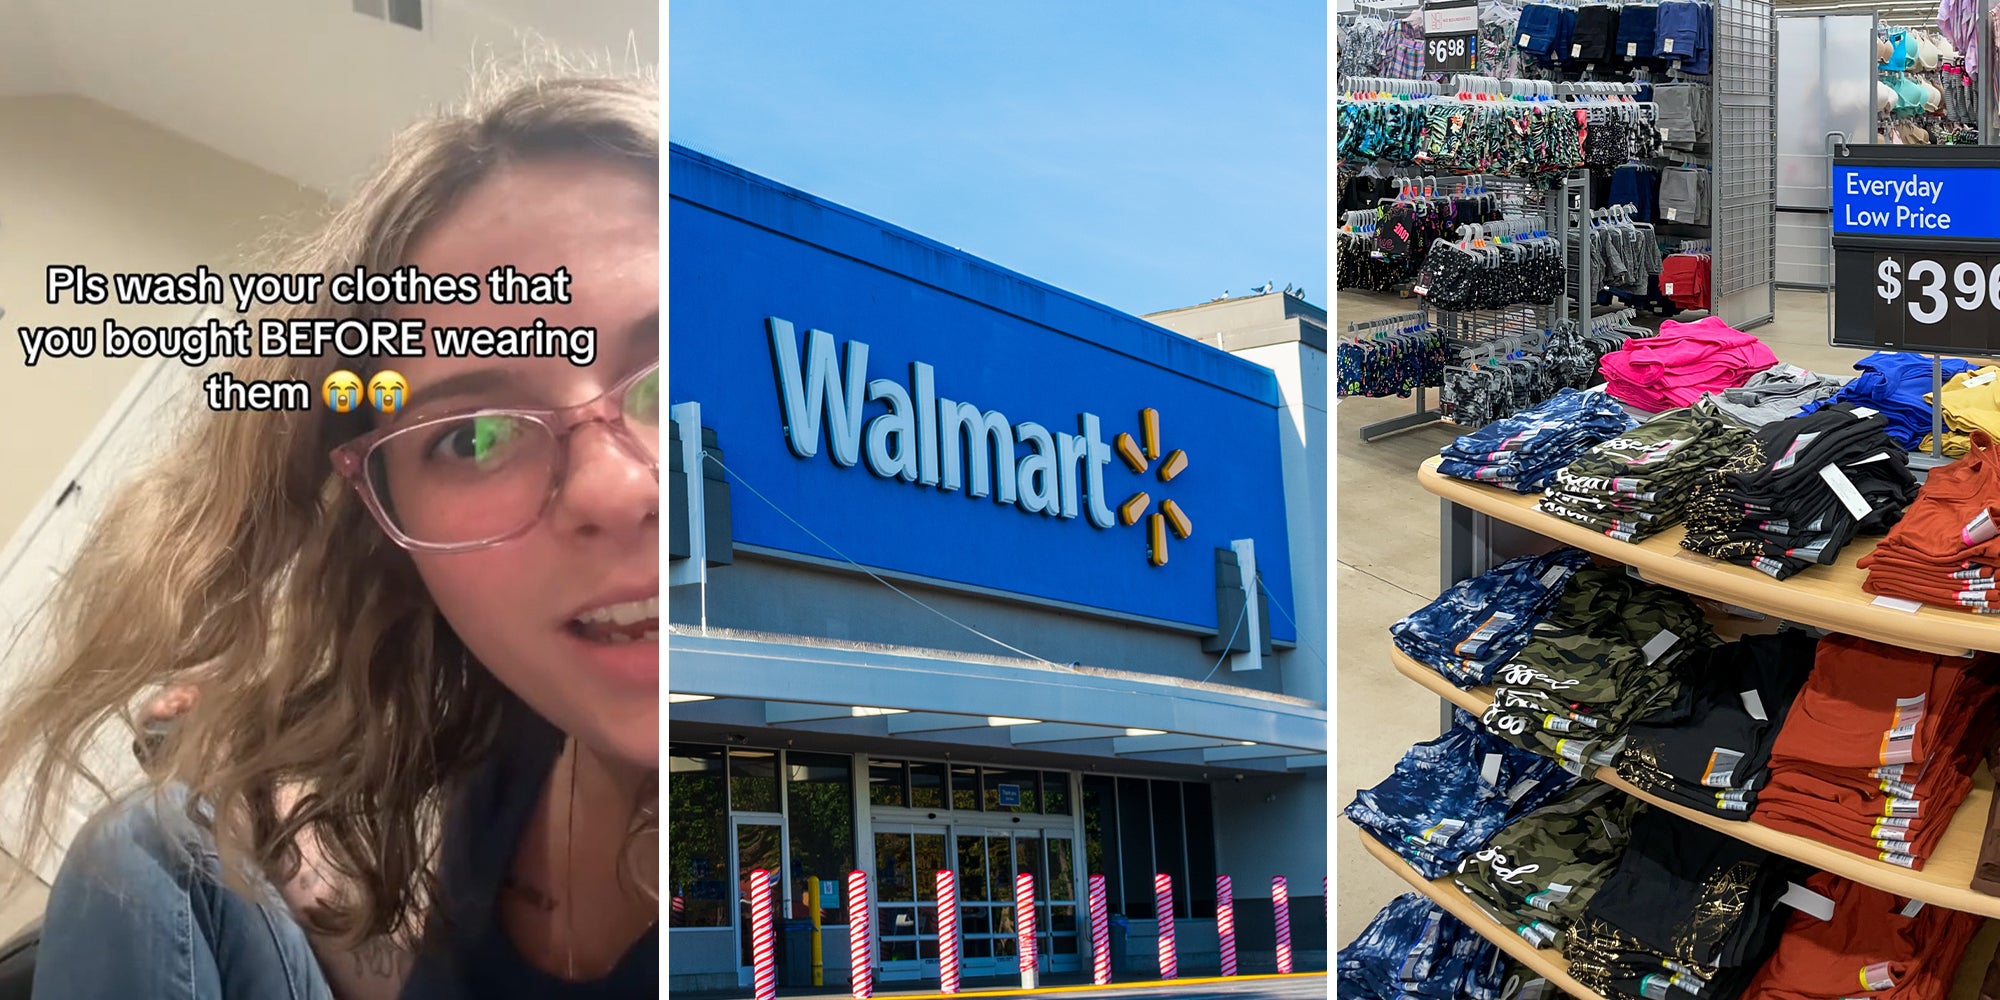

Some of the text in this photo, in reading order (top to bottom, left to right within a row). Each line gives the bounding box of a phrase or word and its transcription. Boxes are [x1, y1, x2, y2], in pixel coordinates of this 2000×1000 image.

[1846, 172, 1943, 204] Everyday
[1845, 204, 1951, 229] Low Price
[765, 316, 1115, 528] Walmart
